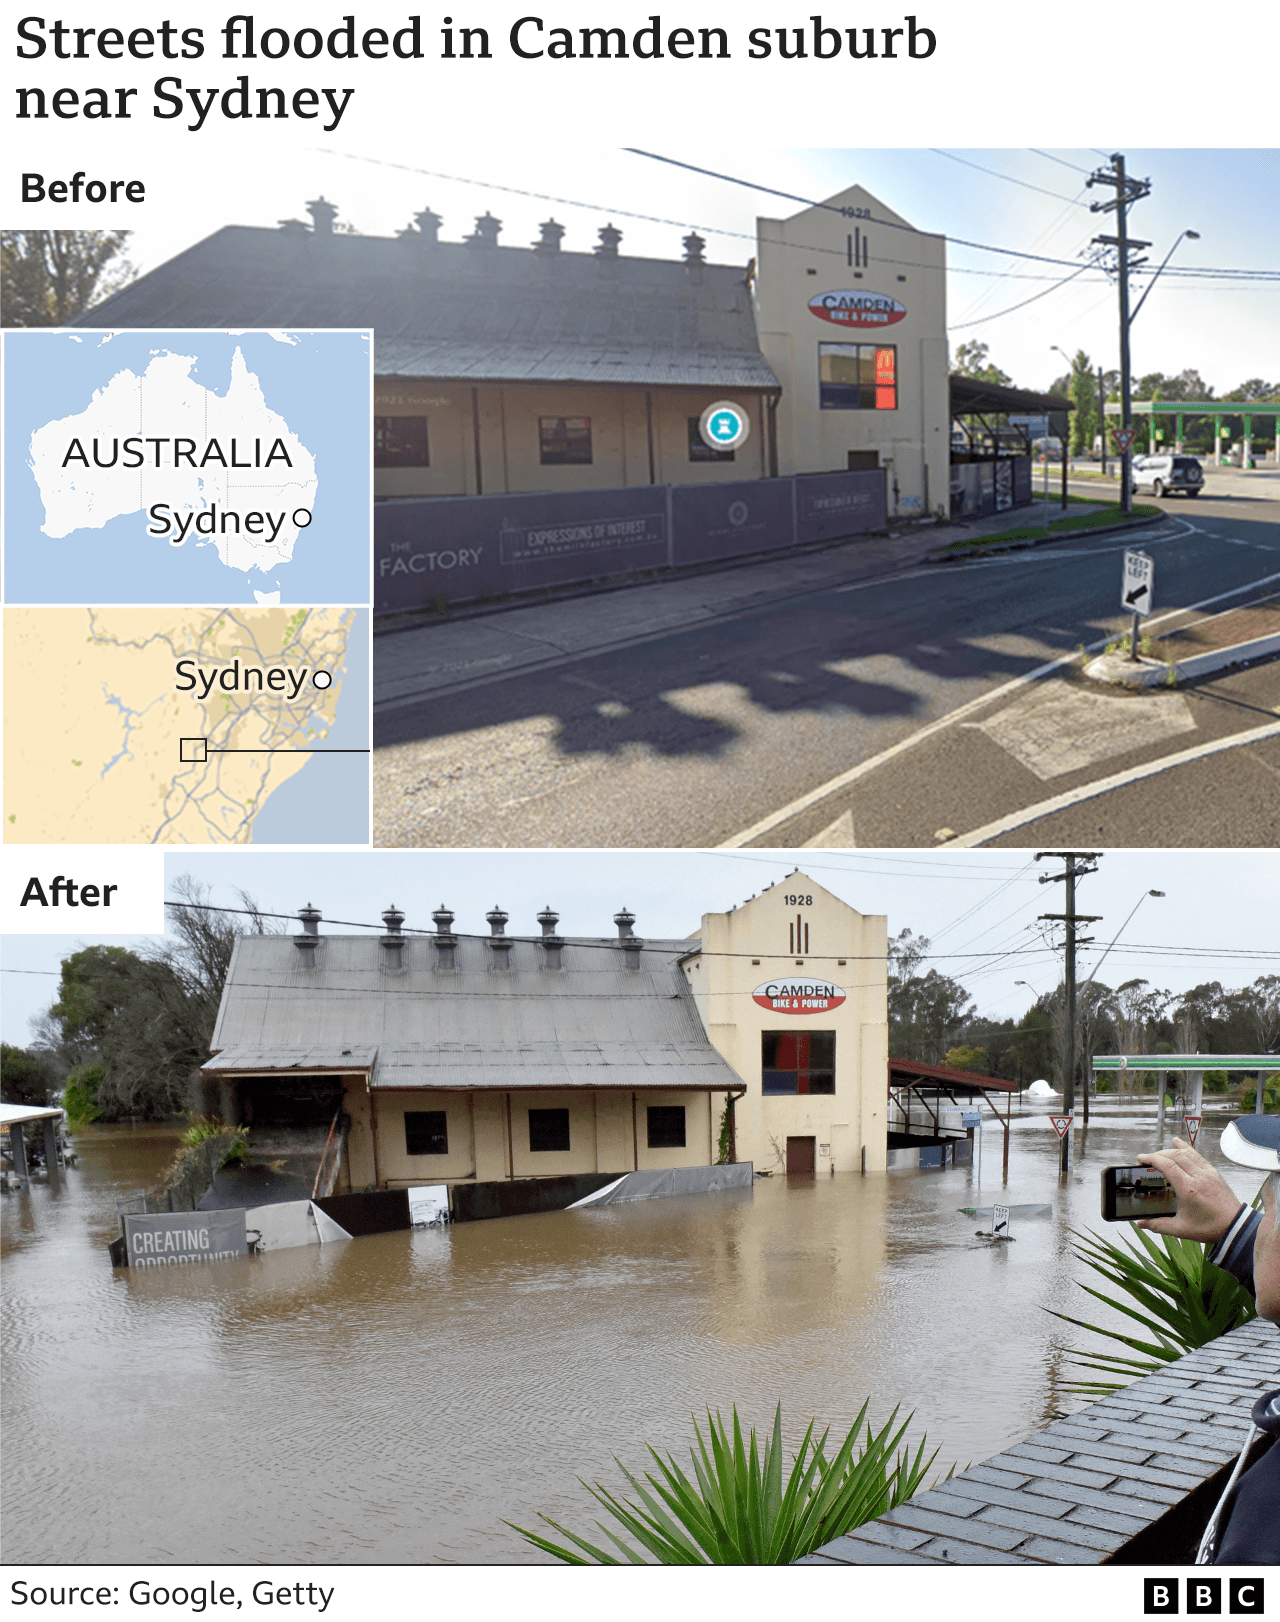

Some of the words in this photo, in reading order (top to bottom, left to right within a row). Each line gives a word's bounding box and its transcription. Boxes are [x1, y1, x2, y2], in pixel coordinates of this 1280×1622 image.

[841, 205, 871, 220] 1928
[822, 295, 895, 314] CAMDEN
[527, 525, 593, 547] EXPRESSIONS
[594, 523, 606, 539] OF
[607, 520, 647, 536] INTEREST
[380, 547, 483, 577] FACTORY
[1128, 556, 1149, 569] KEEP
[1128, 566, 1148, 580] LEFT
[784, 895, 813, 906] 1928
[765, 985, 835, 1000] CAMDEN
[772, 998, 790, 1008] BIKE
[792, 998, 799, 1008] &
[801, 998, 828, 1009] POWER
[132, 1229, 210, 1254] CREATING
